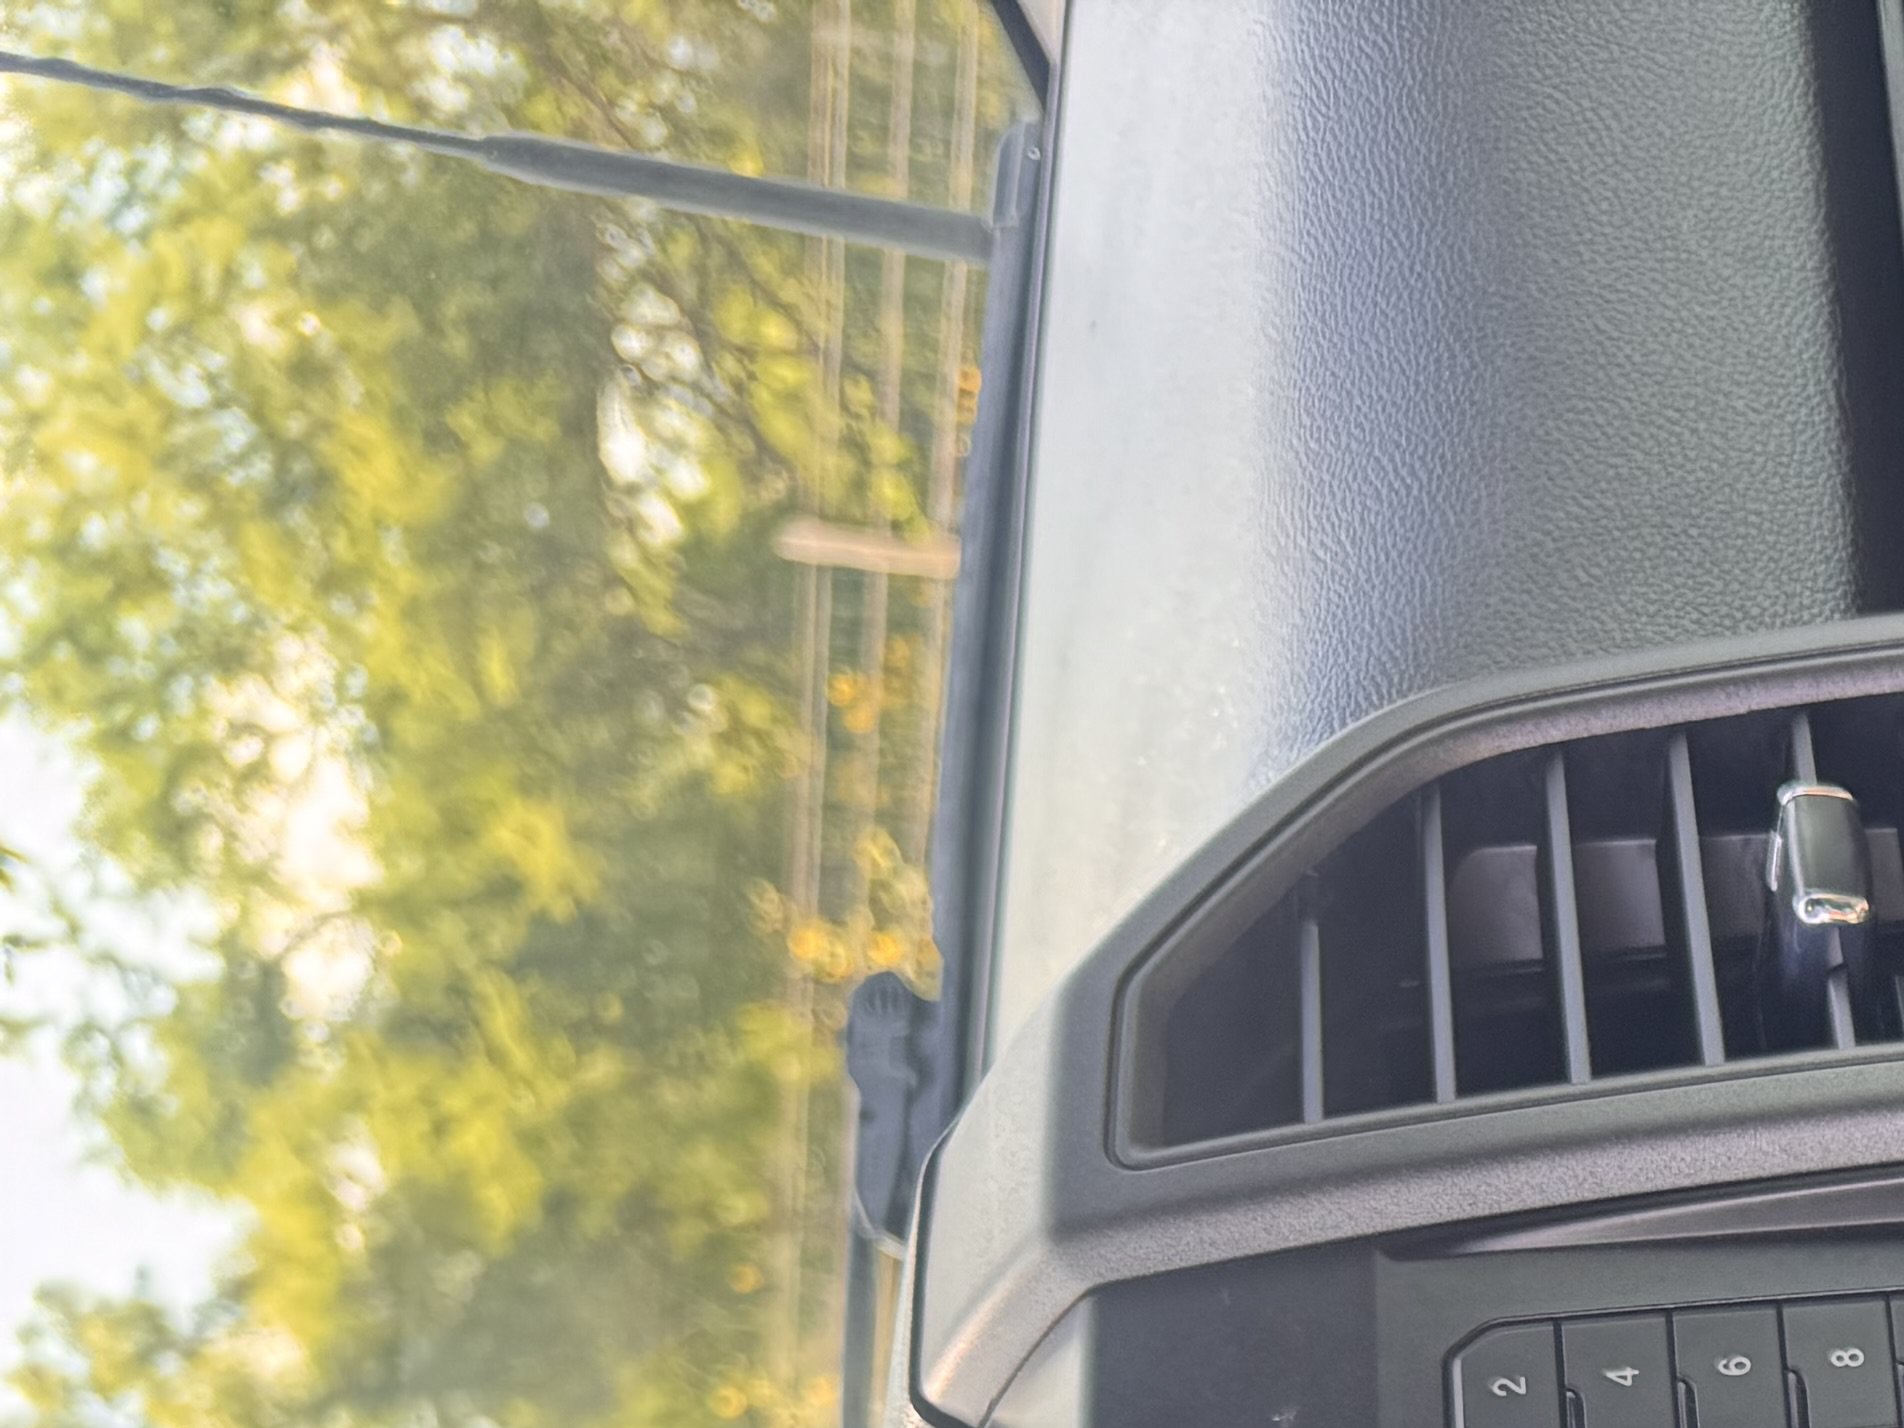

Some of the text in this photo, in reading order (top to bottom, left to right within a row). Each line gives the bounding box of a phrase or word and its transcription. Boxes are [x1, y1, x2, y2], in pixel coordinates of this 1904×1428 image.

[1717, 1356, 1752, 1376] 6
[1830, 1347, 1865, 1367] 8
[1491, 1376, 1527, 1397] 2
[1605, 1366, 1640, 1387] 4
